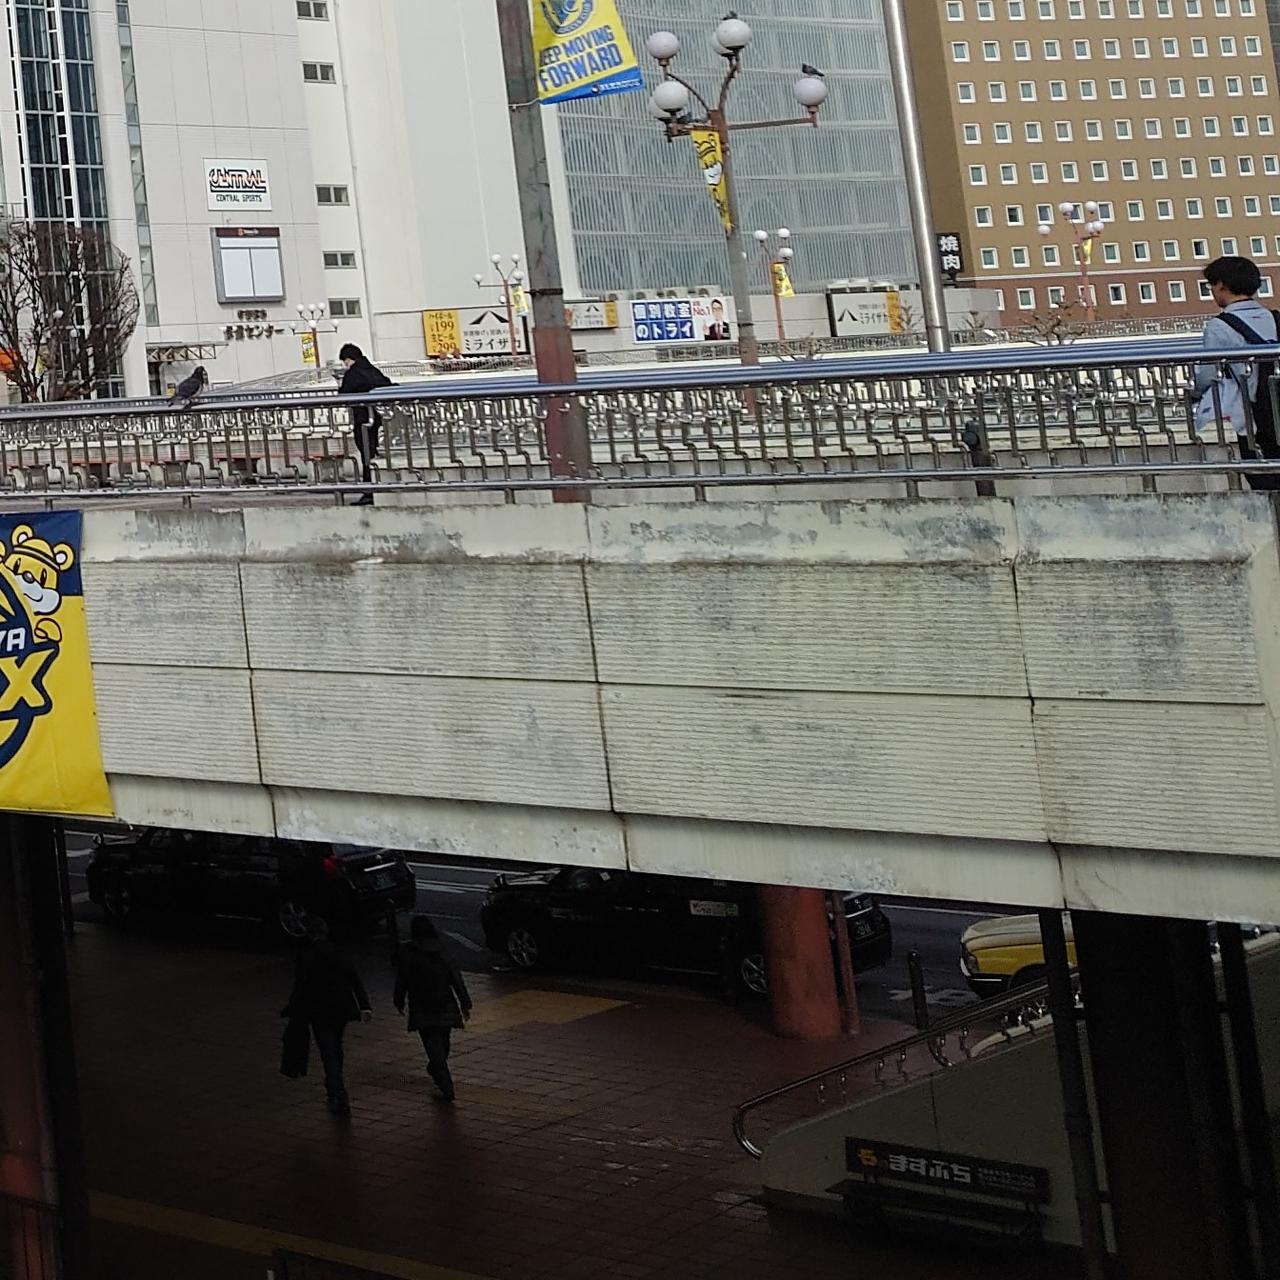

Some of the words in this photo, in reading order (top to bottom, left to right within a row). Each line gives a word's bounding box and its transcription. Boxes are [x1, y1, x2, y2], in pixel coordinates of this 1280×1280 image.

[562, 25, 615, 60] MOVING
[541, 42, 624, 92] FORWARD
[940, 235, 960, 270] 焼肉
[633, 304, 691, 320] 個別教室
[636, 322, 694, 339] のトライ
